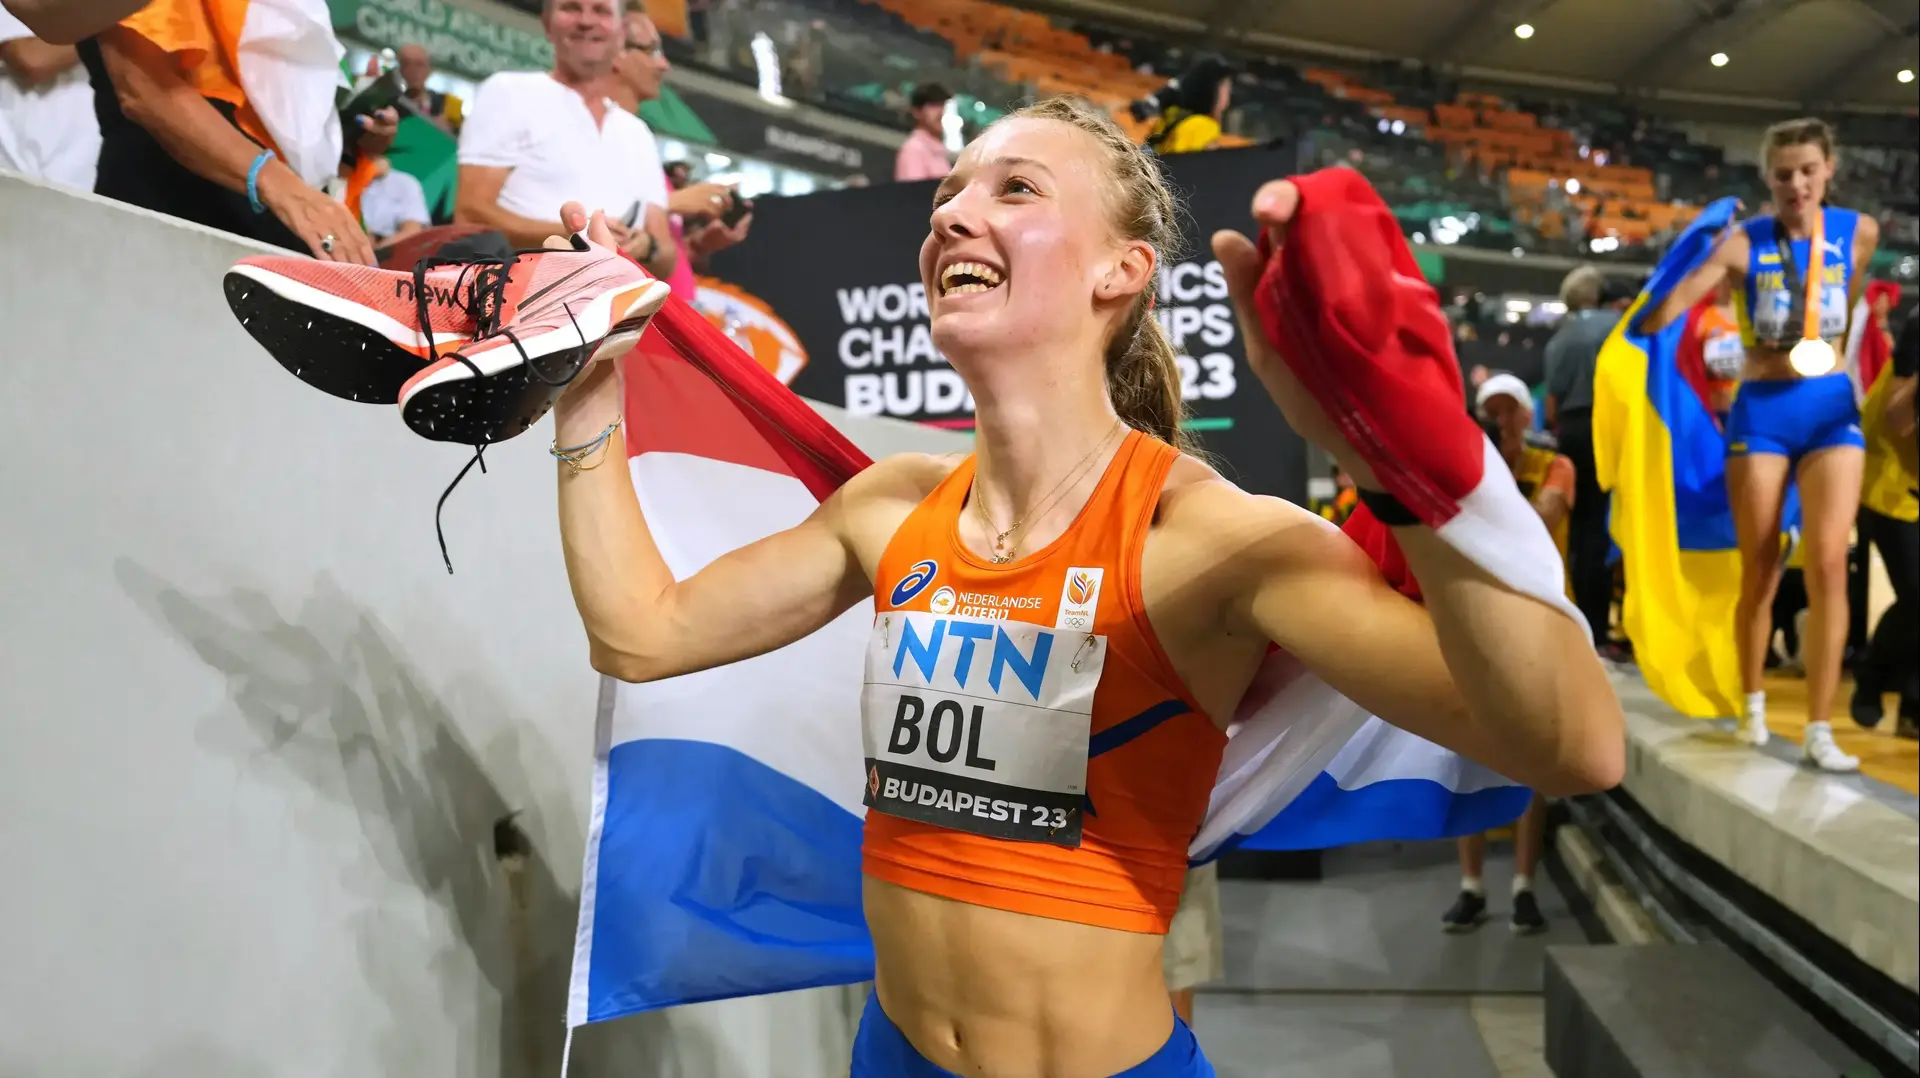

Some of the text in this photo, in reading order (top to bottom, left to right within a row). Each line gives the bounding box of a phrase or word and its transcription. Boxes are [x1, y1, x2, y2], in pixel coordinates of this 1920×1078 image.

[396, 278, 457, 308] new
[955, 605, 1009, 621] LOTERIJ
[958, 591, 1043, 609] NEDERLANDSE
[1064, 609, 1089, 617] TeamNL
[892, 616, 1055, 702] NTN
[887, 694, 997, 771] BOL
[883, 777, 1067, 829] BUDAPEST 23
